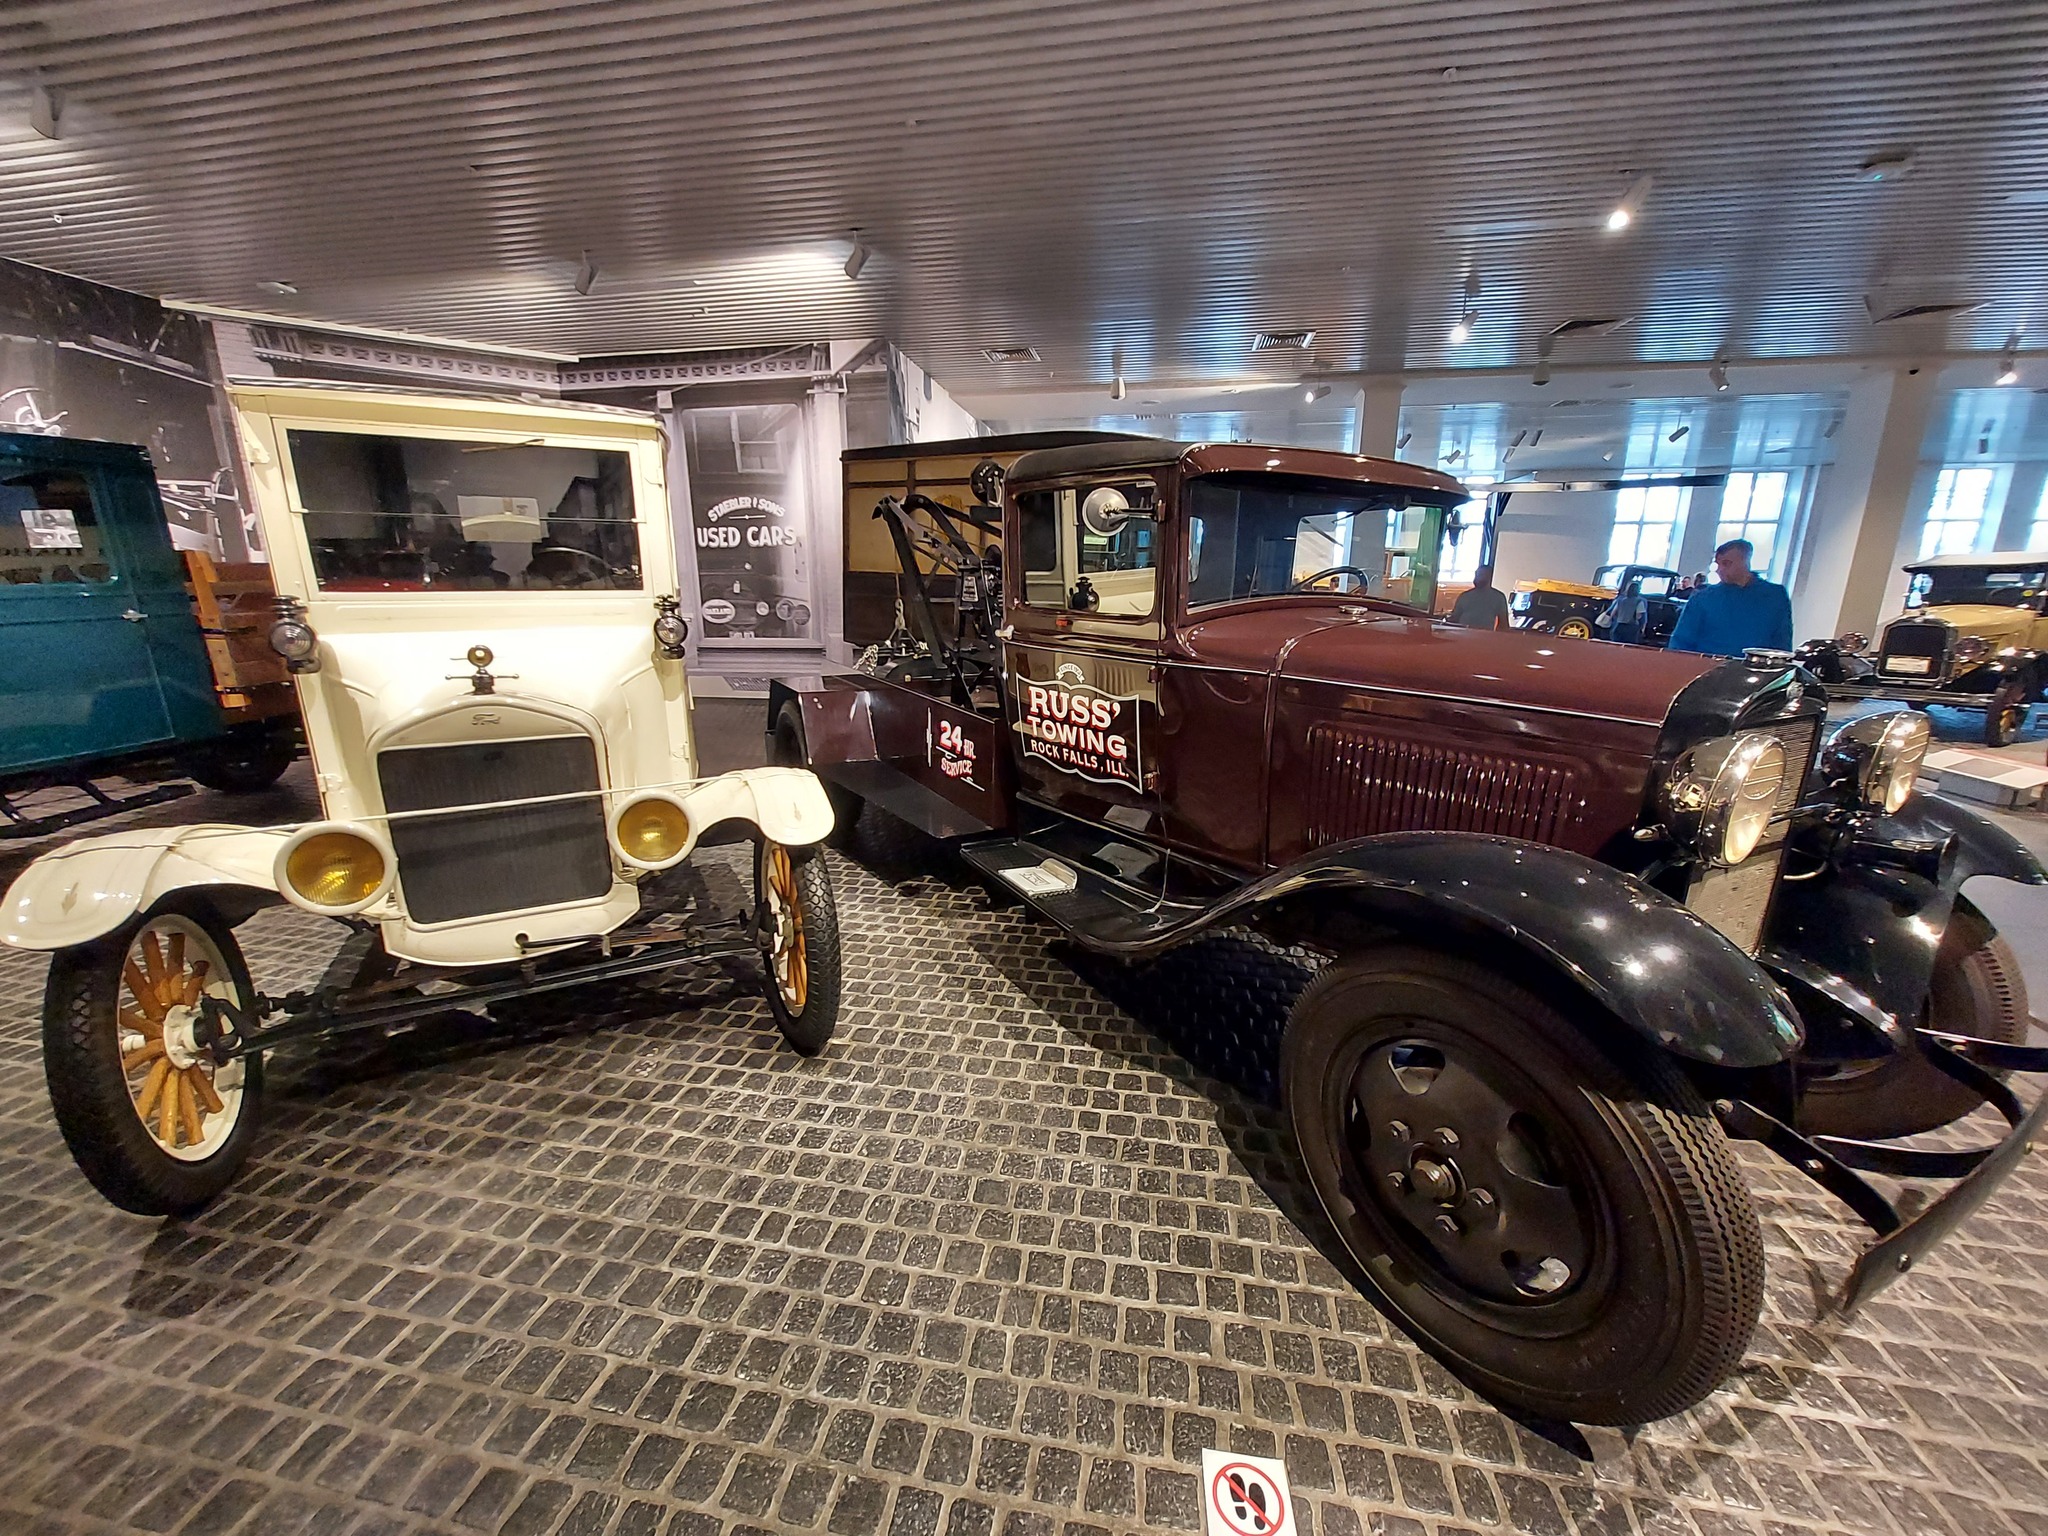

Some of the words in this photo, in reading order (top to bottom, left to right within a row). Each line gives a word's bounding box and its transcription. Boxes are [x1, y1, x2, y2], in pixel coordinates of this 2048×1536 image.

[707, 496, 752, 522] STAEBLER
[757, 498, 786, 517] SONS
[696, 526, 741, 548] USED
[746, 525, 798, 548] CARS
[1028, 686, 1121, 730] RUSS'
[940, 720, 963, 754] 24
[1027, 715, 1128, 759] TOWING
[941, 757, 973, 778] SERVICE
[1031, 739, 1060, 759] ROCK
[1106, 759, 1130, 778] ILL.
